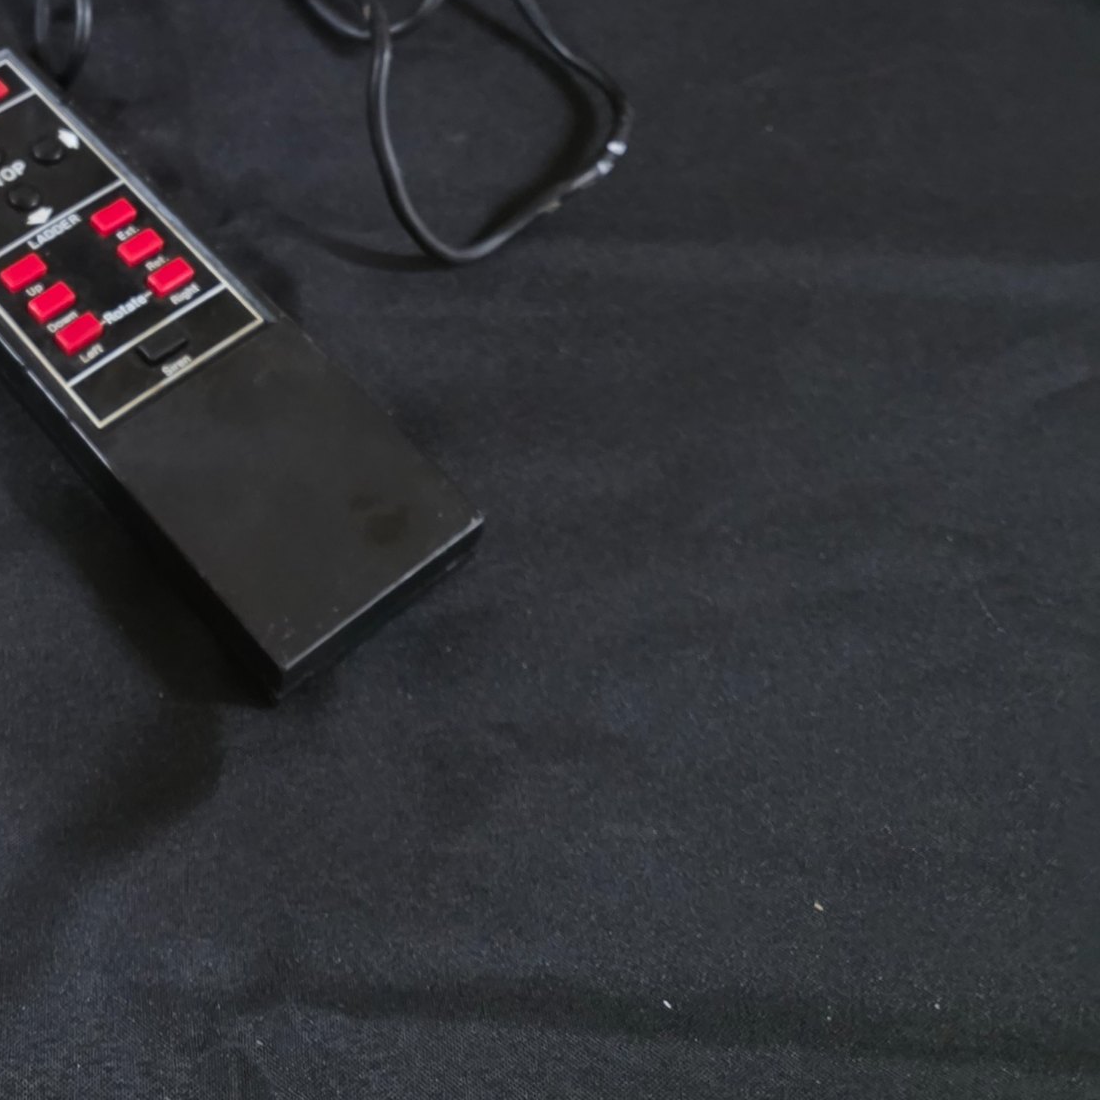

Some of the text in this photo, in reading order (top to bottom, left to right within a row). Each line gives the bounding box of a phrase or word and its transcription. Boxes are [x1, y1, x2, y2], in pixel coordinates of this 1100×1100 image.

[27, 213, 82, 250] LADDER
[115, 224, 140, 242] Ext.
[25, 282, 45, 297] Up
[169, 282, 200, 305] Right
[102, 293, 148, 325] Rotate
[46, 310, 79, 333] Down
[78, 343, 104, 363] Left
[161, 354, 192, 377] Siren
